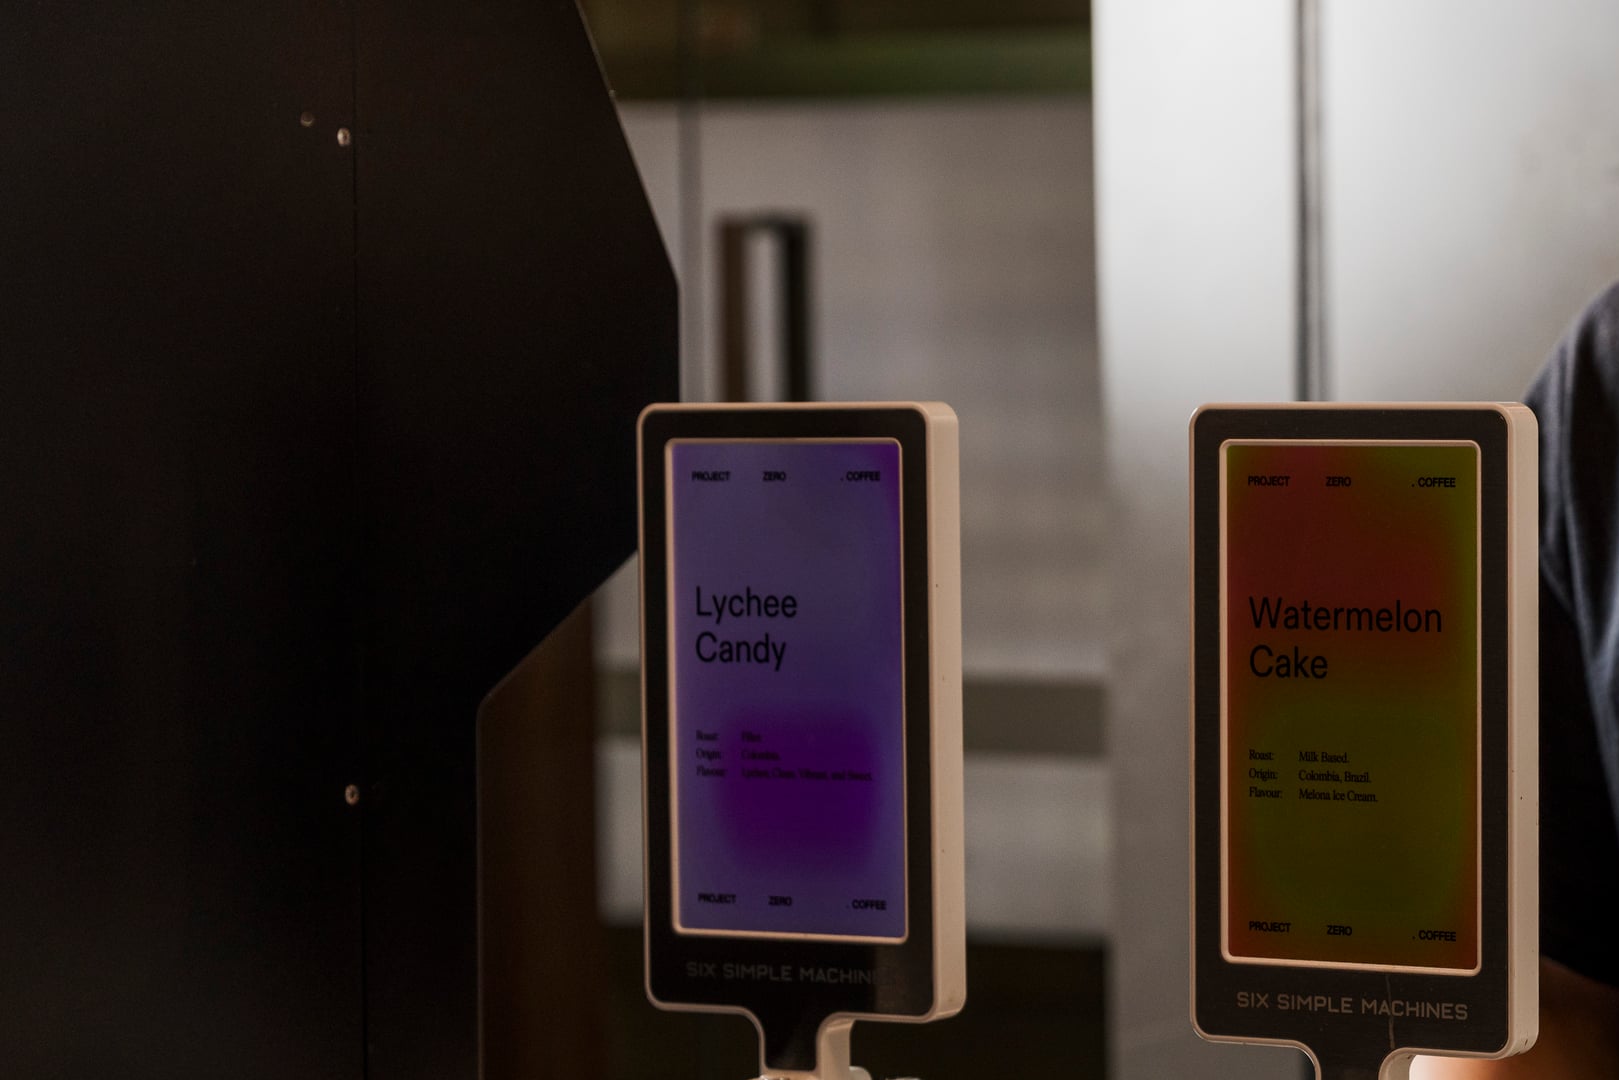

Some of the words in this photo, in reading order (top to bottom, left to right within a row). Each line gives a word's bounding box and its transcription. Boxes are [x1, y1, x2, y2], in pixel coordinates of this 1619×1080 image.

[691, 470, 731, 482] PROJECT
[763, 470, 786, 482] ZERO
[846, 470, 881, 482] COFFEE
[1247, 475, 1290, 487] PROJECT
[1326, 476, 1351, 488] ZERO
[1418, 476, 1456, 488] COFFEE
[695, 585, 798, 625] Lychee
[1248, 596, 1443, 634] Watermelon
[695, 631, 786, 671] Candy
[1248, 645, 1329, 680] Cake
[1298, 751, 1319, 763] Milk
[697, 892, 736, 905] PROJECT
[768, 895, 793, 907] ZERO
[852, 898, 887, 911] COFFEE
[1248, 921, 1291, 934] PROJECT
[1326, 923, 1352, 937] ZERO
[1418, 929, 1457, 942] COFFEE
[685, 961, 717, 978] SIX
[723, 963, 793, 982] SIMPLE
[1236, 991, 1269, 1010] SIX
[1277, 993, 1354, 1014] SIMPLE
[1361, 998, 1469, 1021] MACHINES
